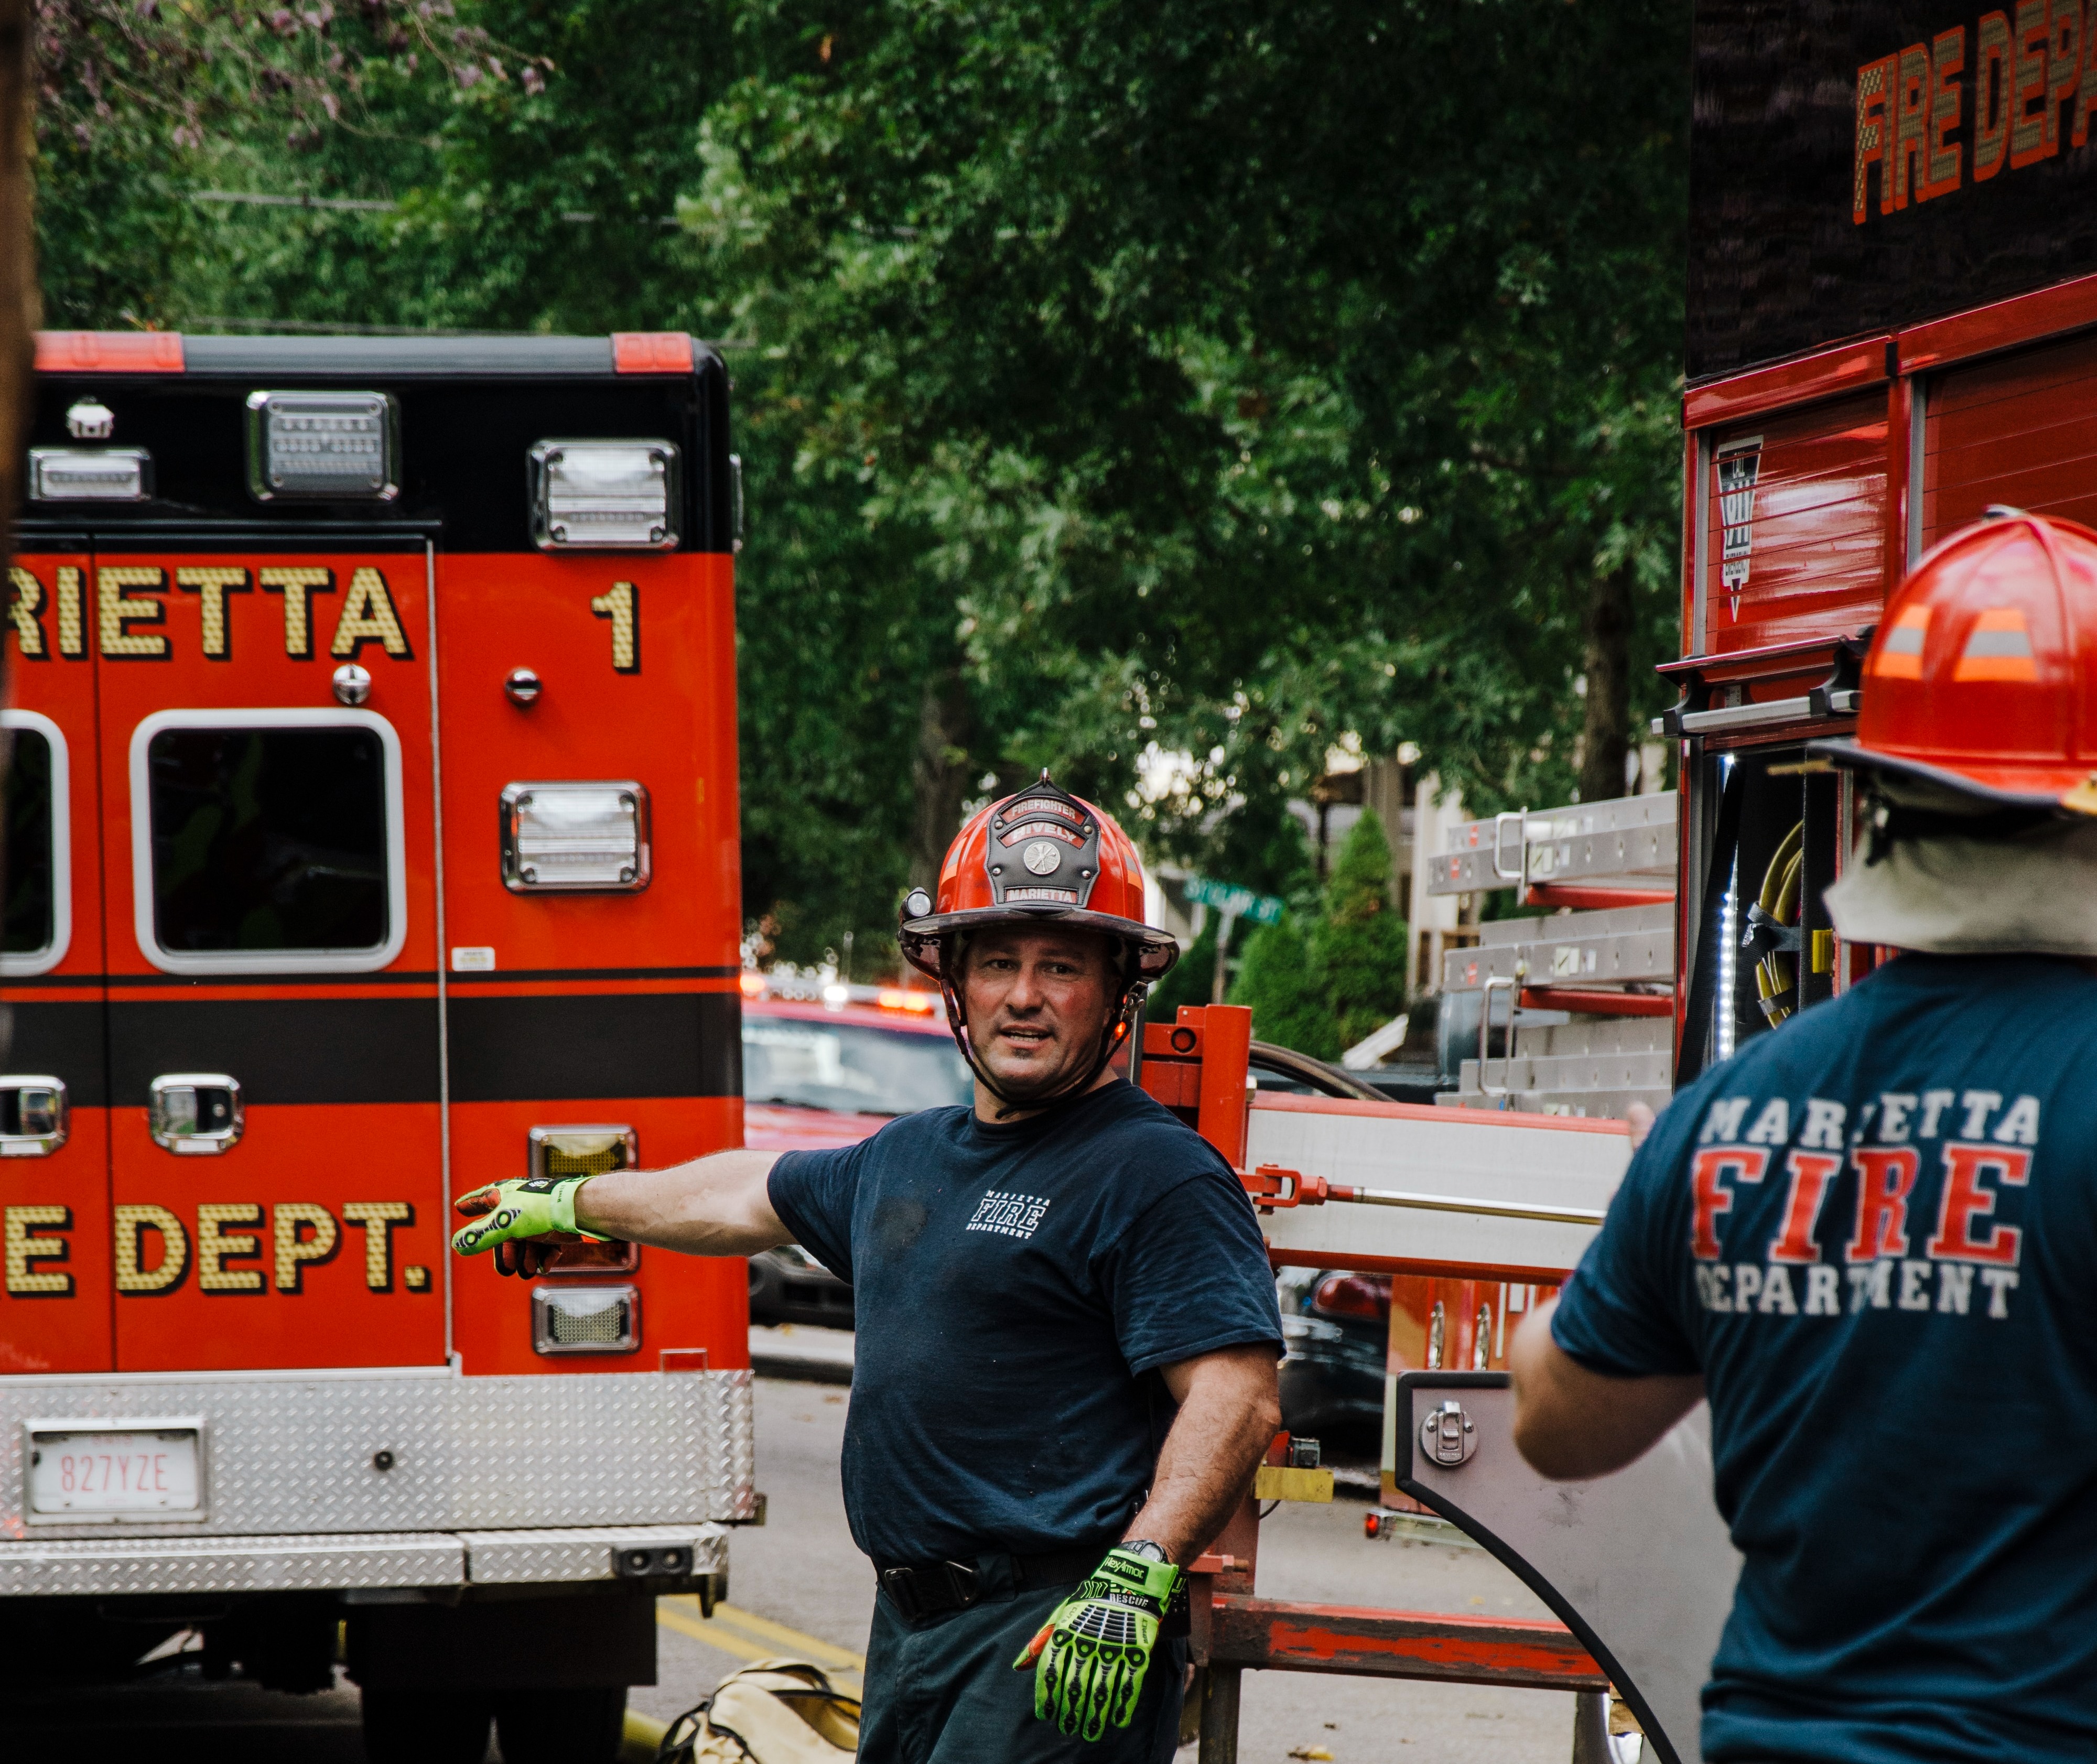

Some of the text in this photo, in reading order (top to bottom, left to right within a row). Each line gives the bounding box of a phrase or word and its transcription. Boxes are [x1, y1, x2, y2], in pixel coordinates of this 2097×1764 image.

[1853, 25, 1965, 225] FIRE
[591, 581, 641, 675] 1
[1012, 798, 1076, 819] FIREFIGHTER
[1013, 821, 1076, 842] HIVELY
[1009, 889, 1073, 903] MARIETTA
[986, 1190, 1050, 1206] MARIETTA
[1690, 1140, 2034, 1267] FIRE
[971, 1198, 1046, 1231] FIRE
[966, 1222, 1032, 1239] DEPARTMENT
[114, 1202, 431, 1296] DEPT.
[61, 1454, 168, 1492] 827YZE
[1104, 1556, 1144, 1579] HexArmor
[1109, 1593, 1149, 1607] RESCUE
